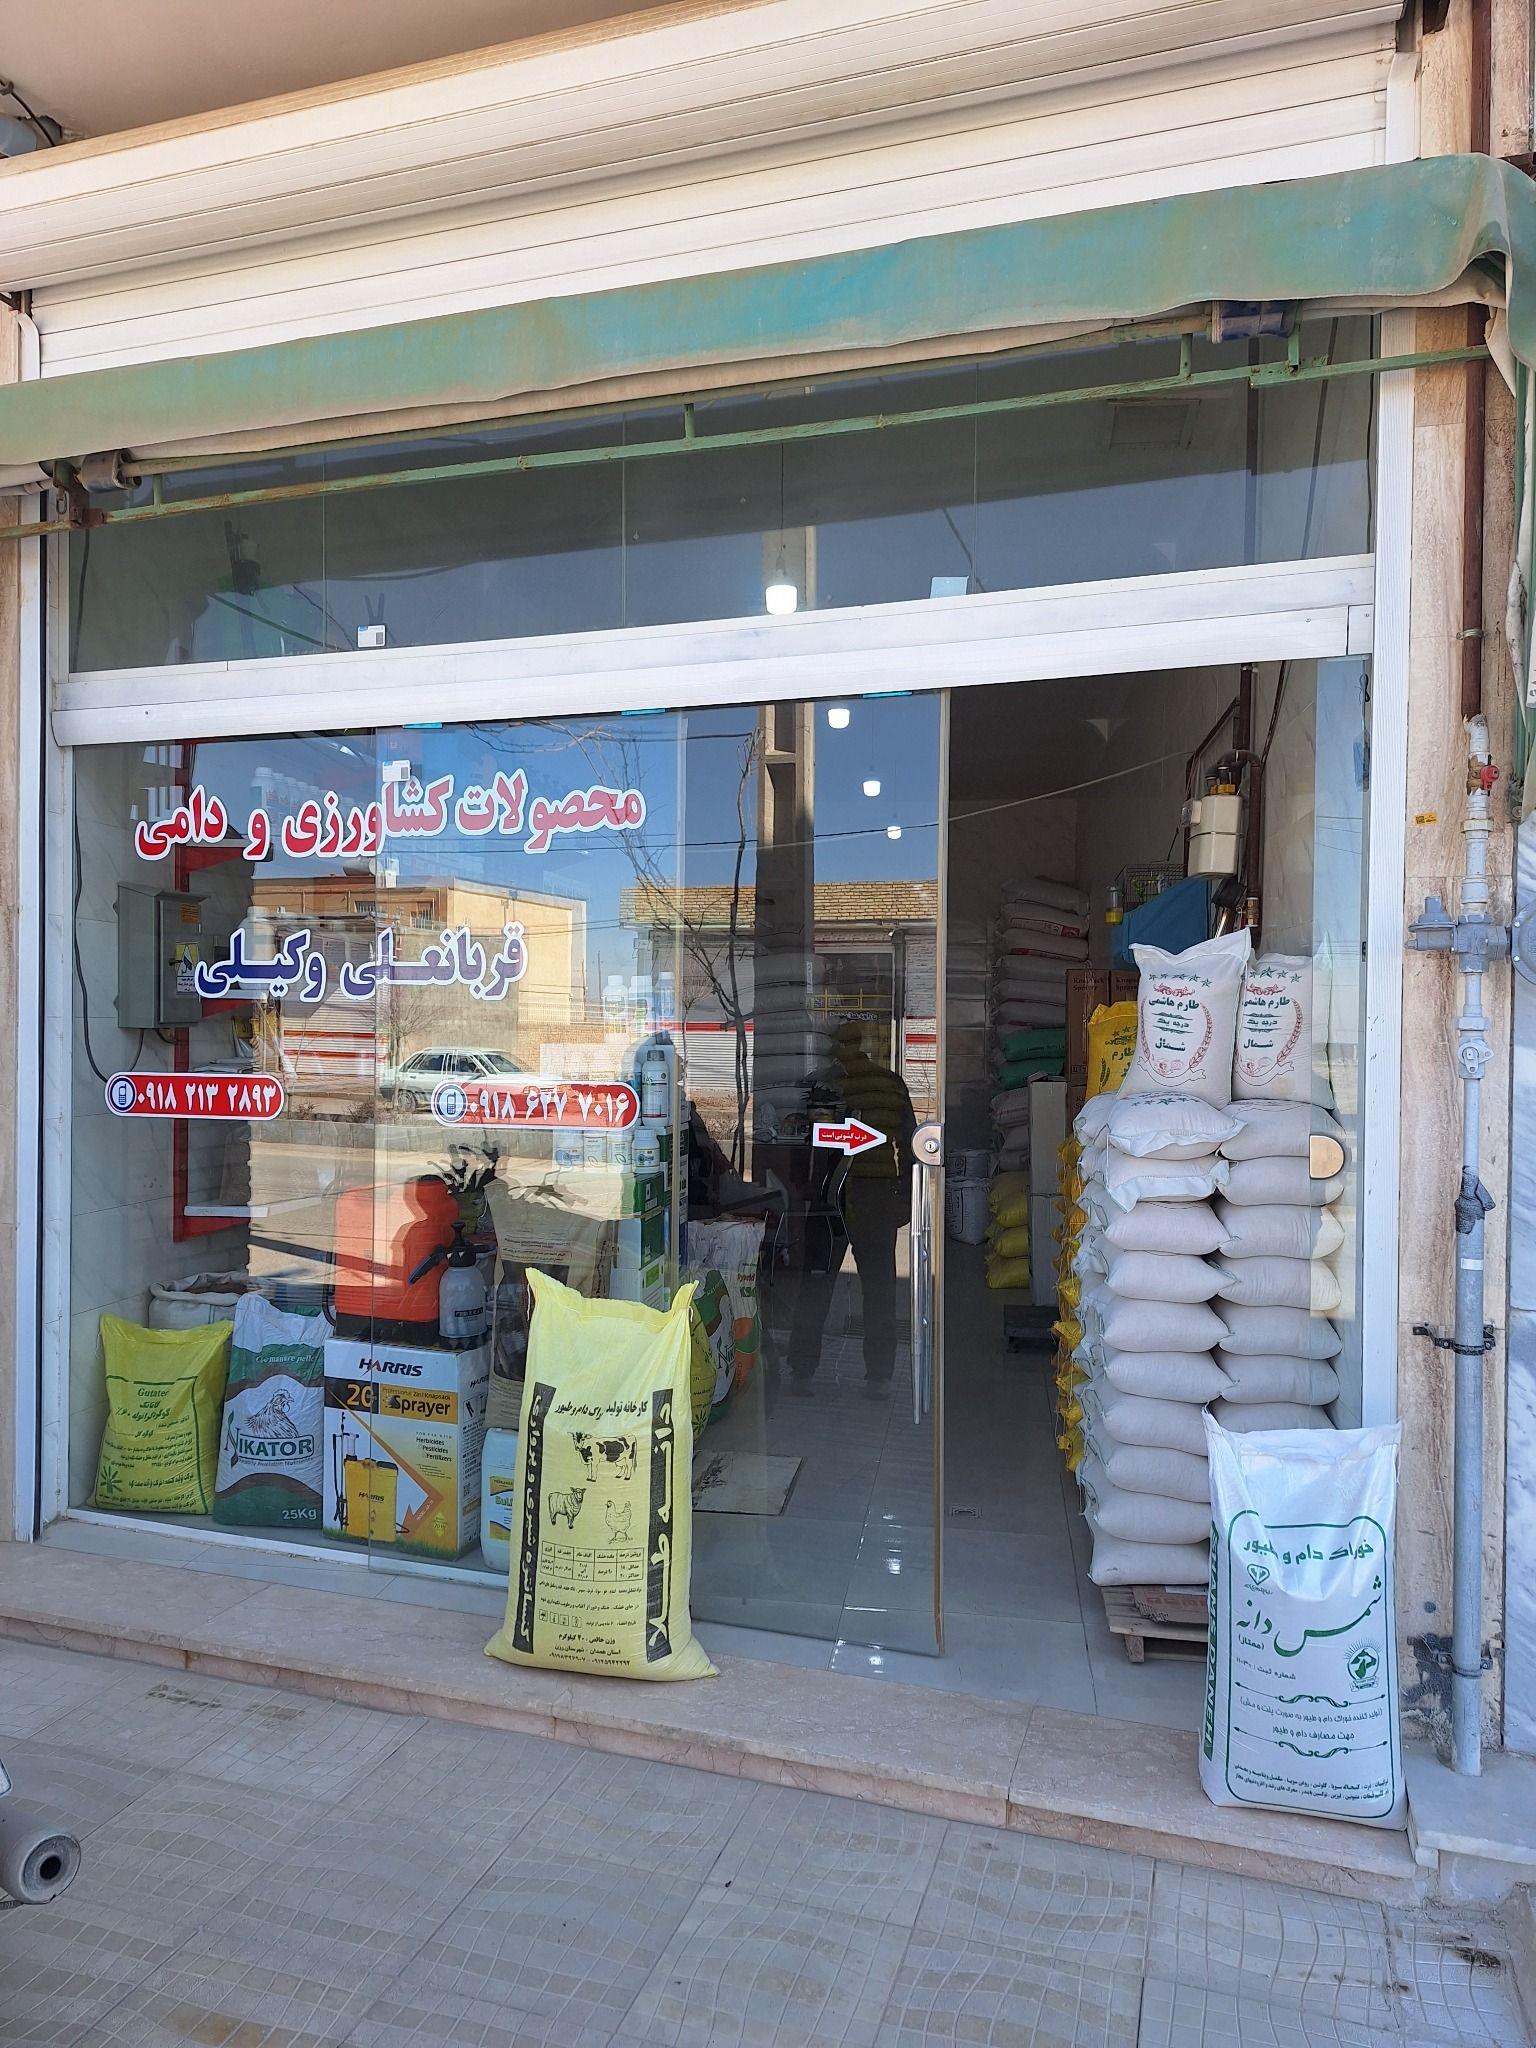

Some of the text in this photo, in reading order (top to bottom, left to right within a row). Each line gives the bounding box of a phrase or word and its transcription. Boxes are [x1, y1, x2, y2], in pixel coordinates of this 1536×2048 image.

[135, 769, 646, 861] محصولات کشاورزی و دامی
[195, 922, 527, 1002] قربانعلی وکیلی
[1149, 997, 1200, 1011] طارم هاشمی
[1242, 997, 1290, 1010] طارم هاشمی
[1157, 1018, 1190, 1028] درجه یک
[1247, 1019, 1259, 1027] یک
[1155, 1037, 1186, 1051] شمال
[1244, 1038, 1273, 1049] شمال
[138, 1081, 277, 1113] ۰۹۱۸ ۲۱۳ ۲۸۹۳
[470, 1088, 515, 1121] ۰۹۱۸
[578, 1092, 630, 1123] ۷۰۱۶
[359, 1358, 423, 1377] HARRIS
[346, 1384, 373, 1408] 20
[393, 1395, 450, 1417] Sprayer
[606, 1401, 623, 1417] تولید
[224, 1428, 313, 1459] NIKATOR
[416, 1437, 445, 1446] Herbicides
[422, 1445, 449, 1454] Pesticides
[282, 1507, 317, 1520] 25Kg
[525, 1487, 536, 1547] شیری
[1244, 1539, 1374, 1565] خوراک دام و طیور
[1236, 1600, 1273, 1634] دانه
[1204, 1526, 1218, 1744] SHAMS DANEH
[1238, 1634, 1265, 1650] (ممتاز)
[1274, 1671, 1296, 1681] شماره
[1272, 1725, 1289, 1735] طیور
[1296, 1730, 1307, 1738] دام
[1310, 1729, 1336, 1740] مصارف
[1337, 1731, 1355, 1740] جهت
